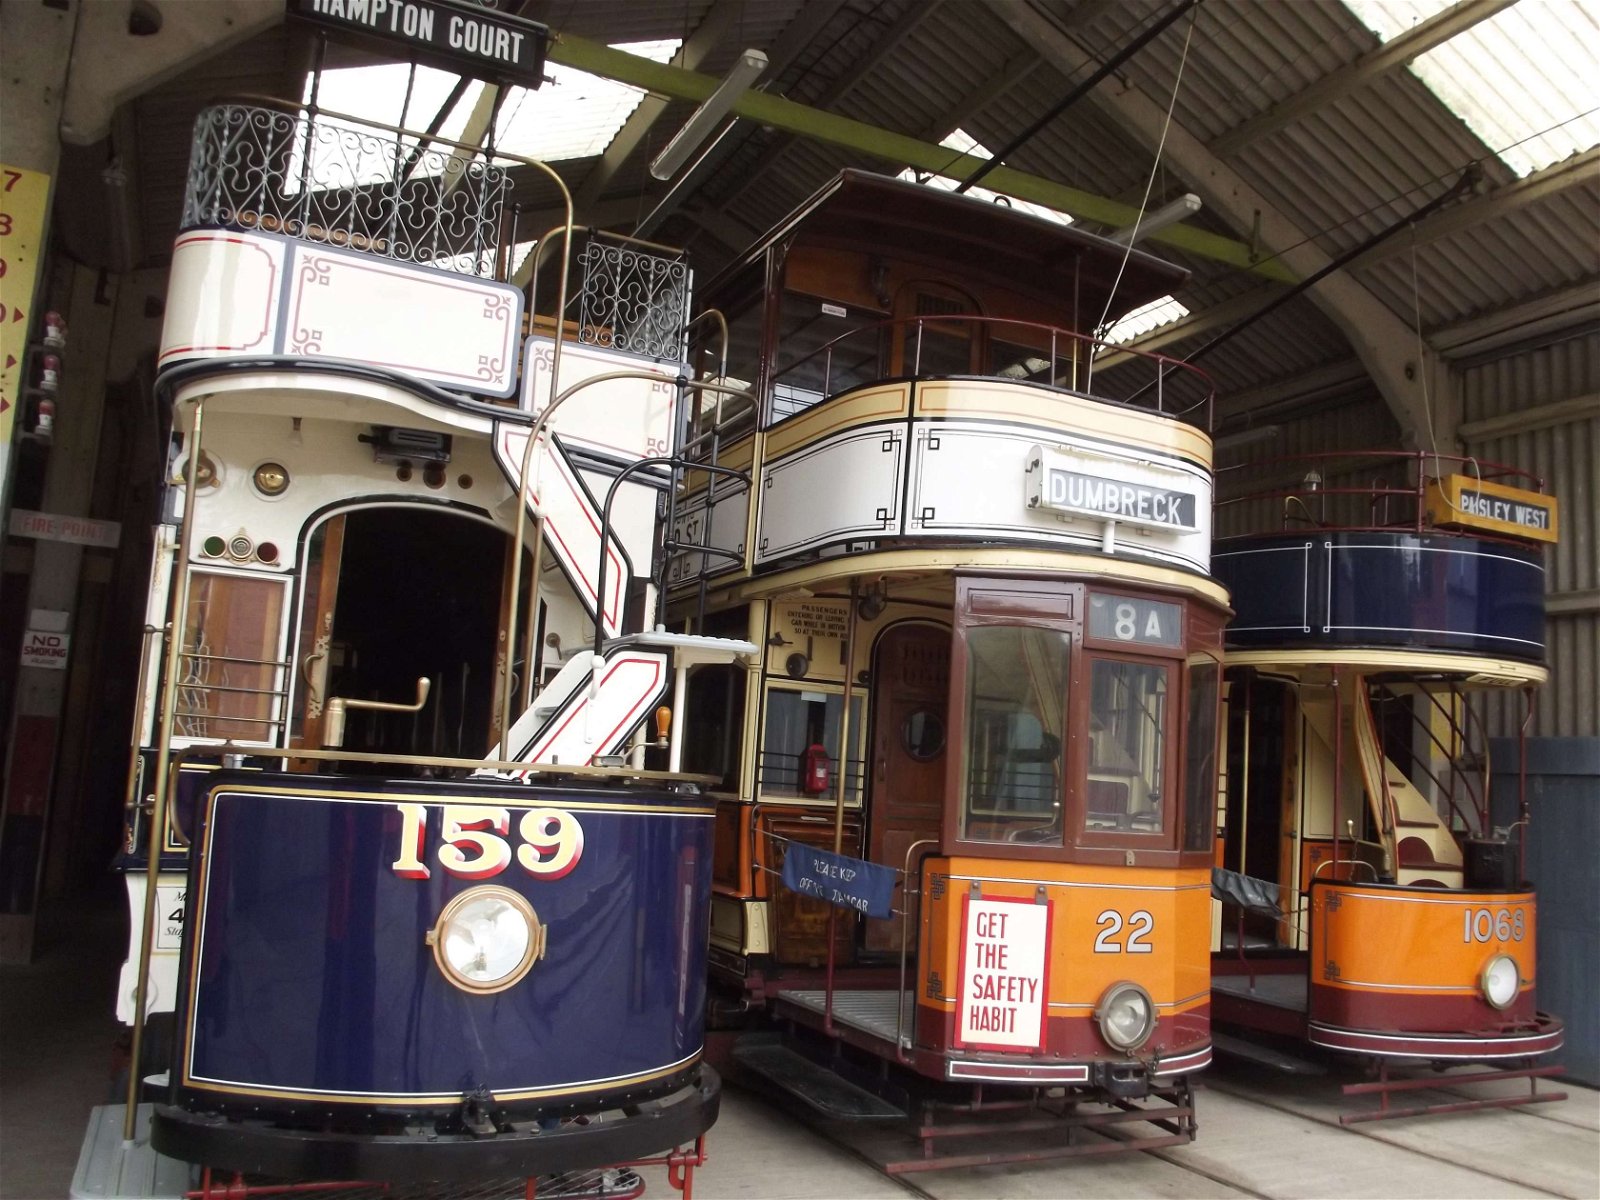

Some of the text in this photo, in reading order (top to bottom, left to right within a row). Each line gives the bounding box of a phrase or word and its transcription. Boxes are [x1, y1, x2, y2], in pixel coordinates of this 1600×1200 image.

[449, 16, 525, 64] COURT
[1051, 473, 1182, 526] DUMBRECK
[1461, 495, 1547, 529] PAISLEY WEST
[23, 516, 105, 539] FIRE POINT
[788, 611, 813, 619] ENTERING
[802, 605, 847, 615] PASSENGERS
[804, 620, 818, 628] WHILE
[23, 646, 67, 658] SMOKING
[32, 635, 61, 647] NO
[392, 802, 584, 881] 159
[976, 911, 1009, 939] GET
[1093, 908, 1154, 954] 22
[1464, 908, 1526, 943] 1068
[975, 942, 1009, 970] THE
[972, 973, 1039, 1003] SAFETY
[969, 1004, 1018, 1033] HABIT
